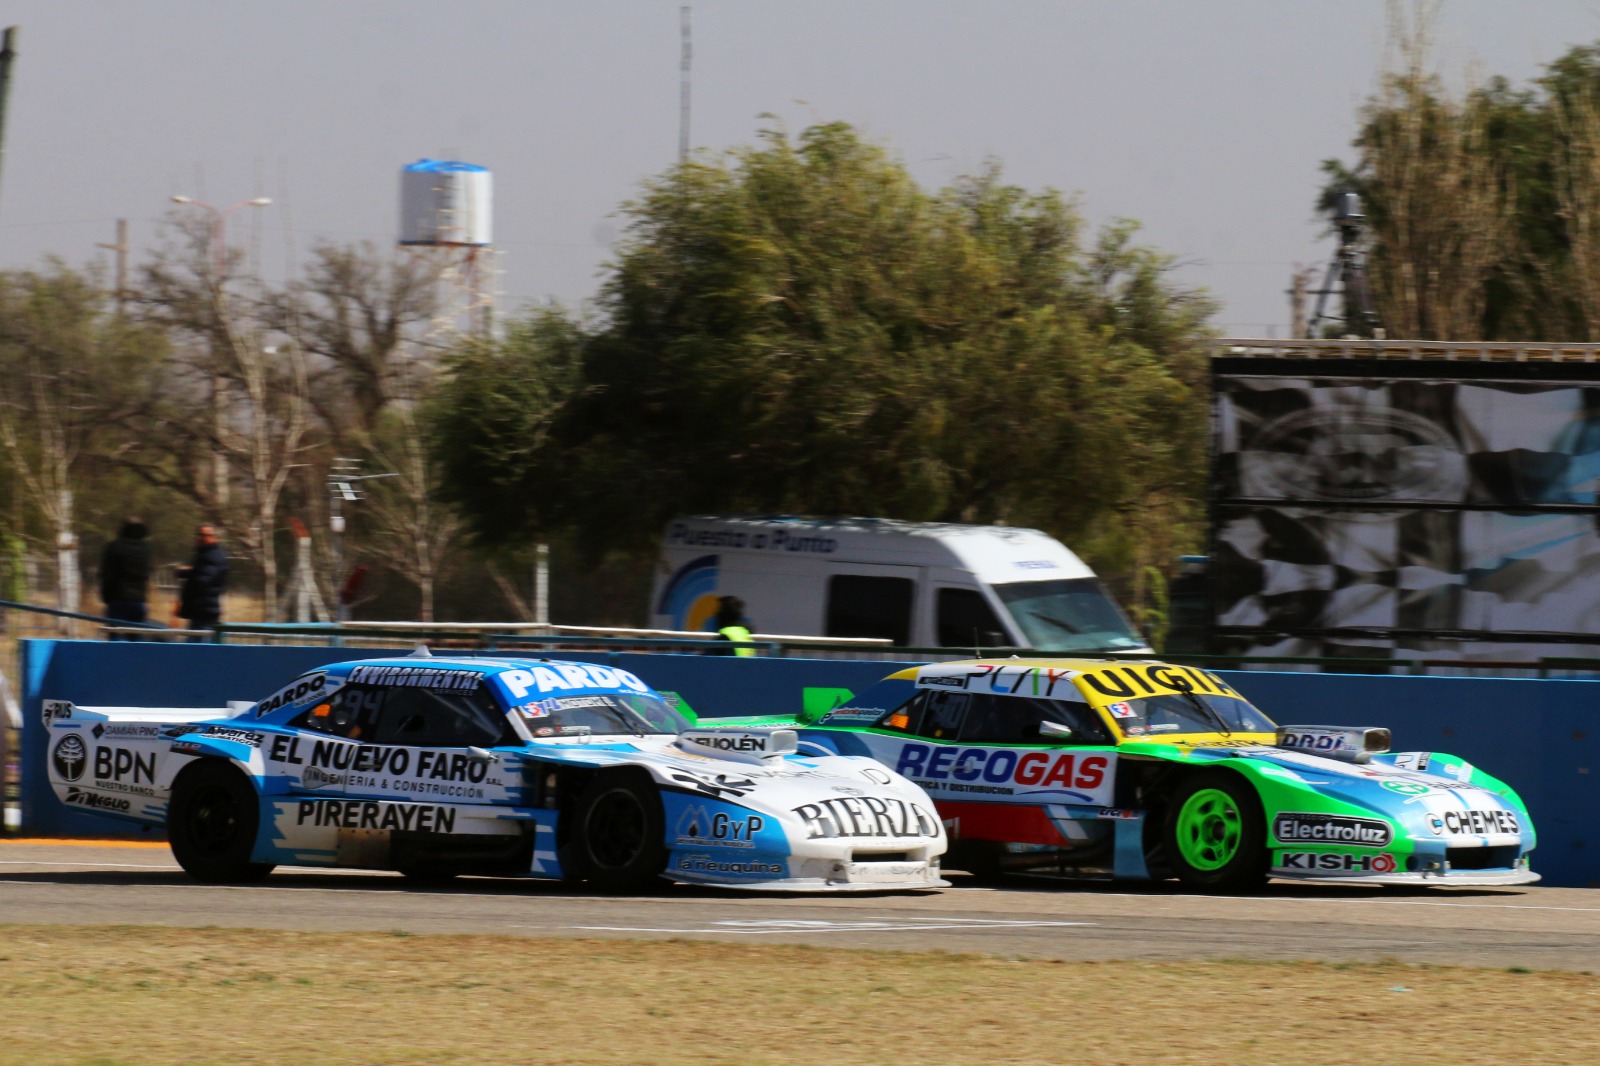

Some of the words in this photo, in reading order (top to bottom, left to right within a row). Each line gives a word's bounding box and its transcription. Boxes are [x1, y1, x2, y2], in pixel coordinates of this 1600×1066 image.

[347, 665, 485, 690] ENVIRONMENTAL
[499, 664, 648, 699] PARDO
[256, 675, 326, 718] PARDO
[206, 725, 265, 744] Alvarez
[94, 745, 156, 785] BPN
[269, 735, 303, 765] EL
[311, 740, 409, 776] NUEVO
[417, 751, 487, 784] FARO
[896, 743, 1109, 790] RECOGAS
[306, 768, 377, 788] INGENIERIA
[380, 779, 389, 789] &
[392, 779, 484, 799] CONSTRUCCIÓN
[296, 800, 456, 833] PIRERAYEN
[1279, 820, 1387, 842] Electroluz
[1444, 810, 1519, 834] CHEMES
[695, 859, 783, 874] neuquina
